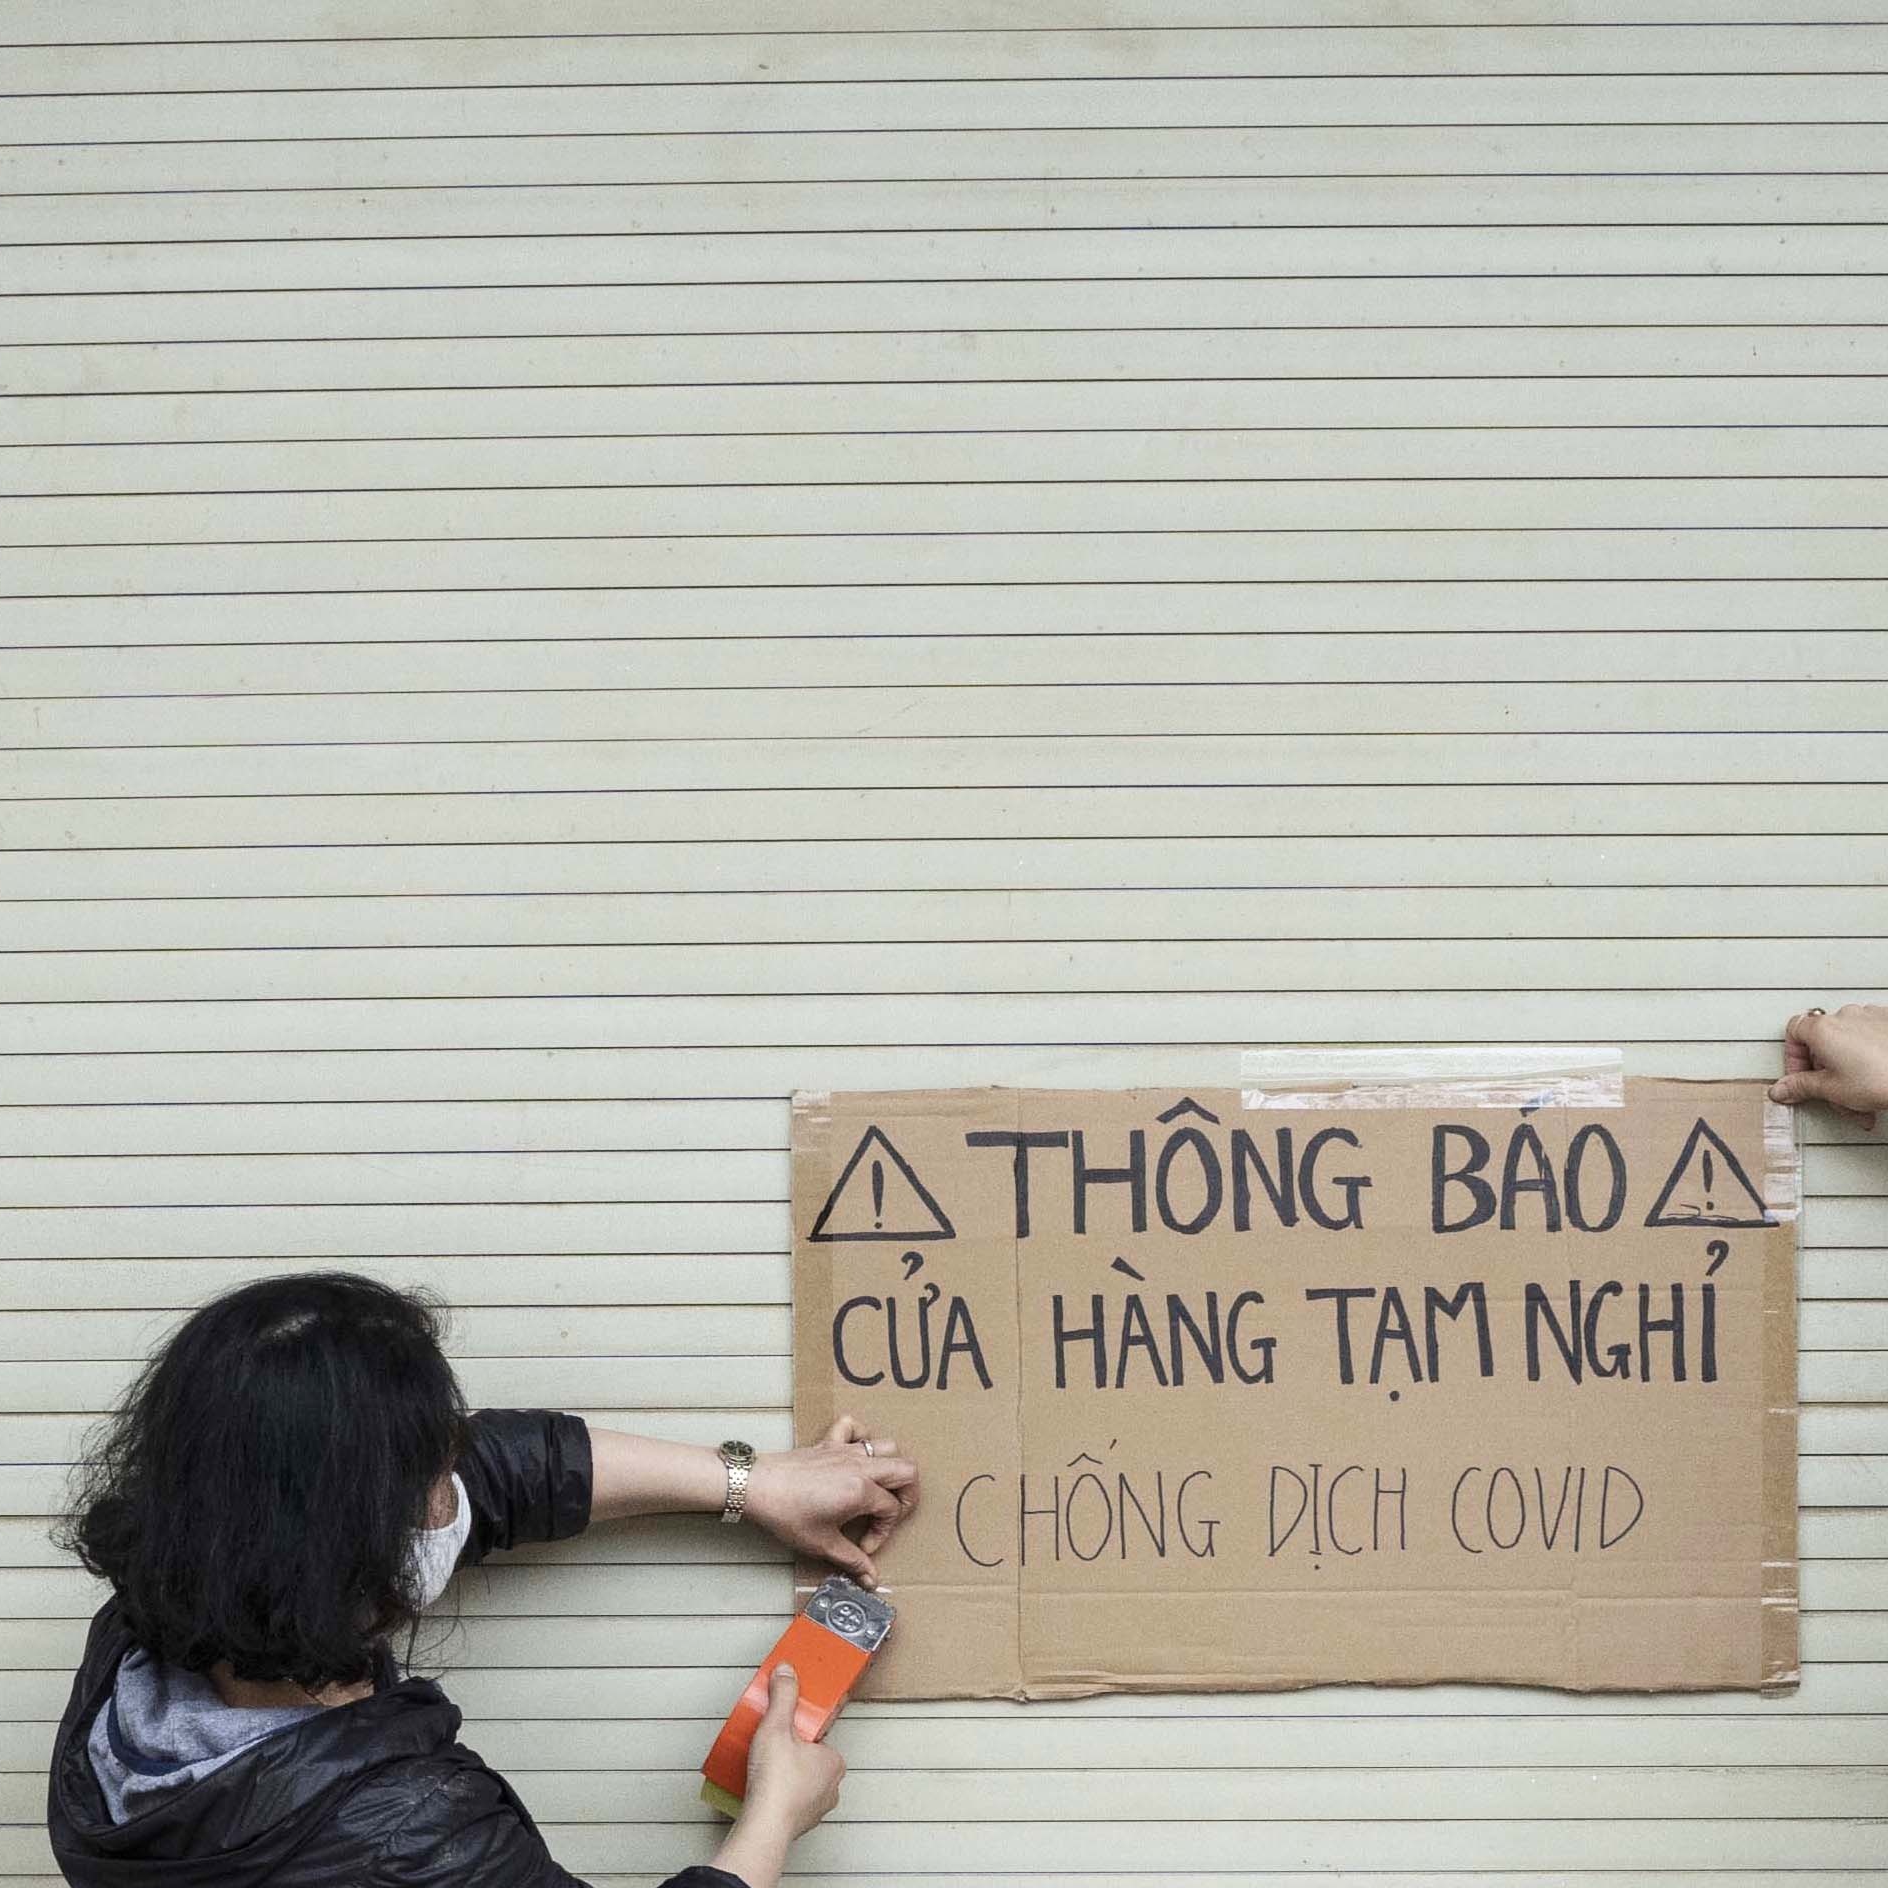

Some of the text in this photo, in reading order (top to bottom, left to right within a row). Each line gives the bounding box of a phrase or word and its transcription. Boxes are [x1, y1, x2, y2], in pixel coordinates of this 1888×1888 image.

[965, 1092, 1627, 1238] THÔNG BÁO
[833, 1239, 1729, 1401] CỬA HÀNG TẠM NGHỈ
[956, 1439, 1644, 1570] CHỐNG DỊCH COVID
